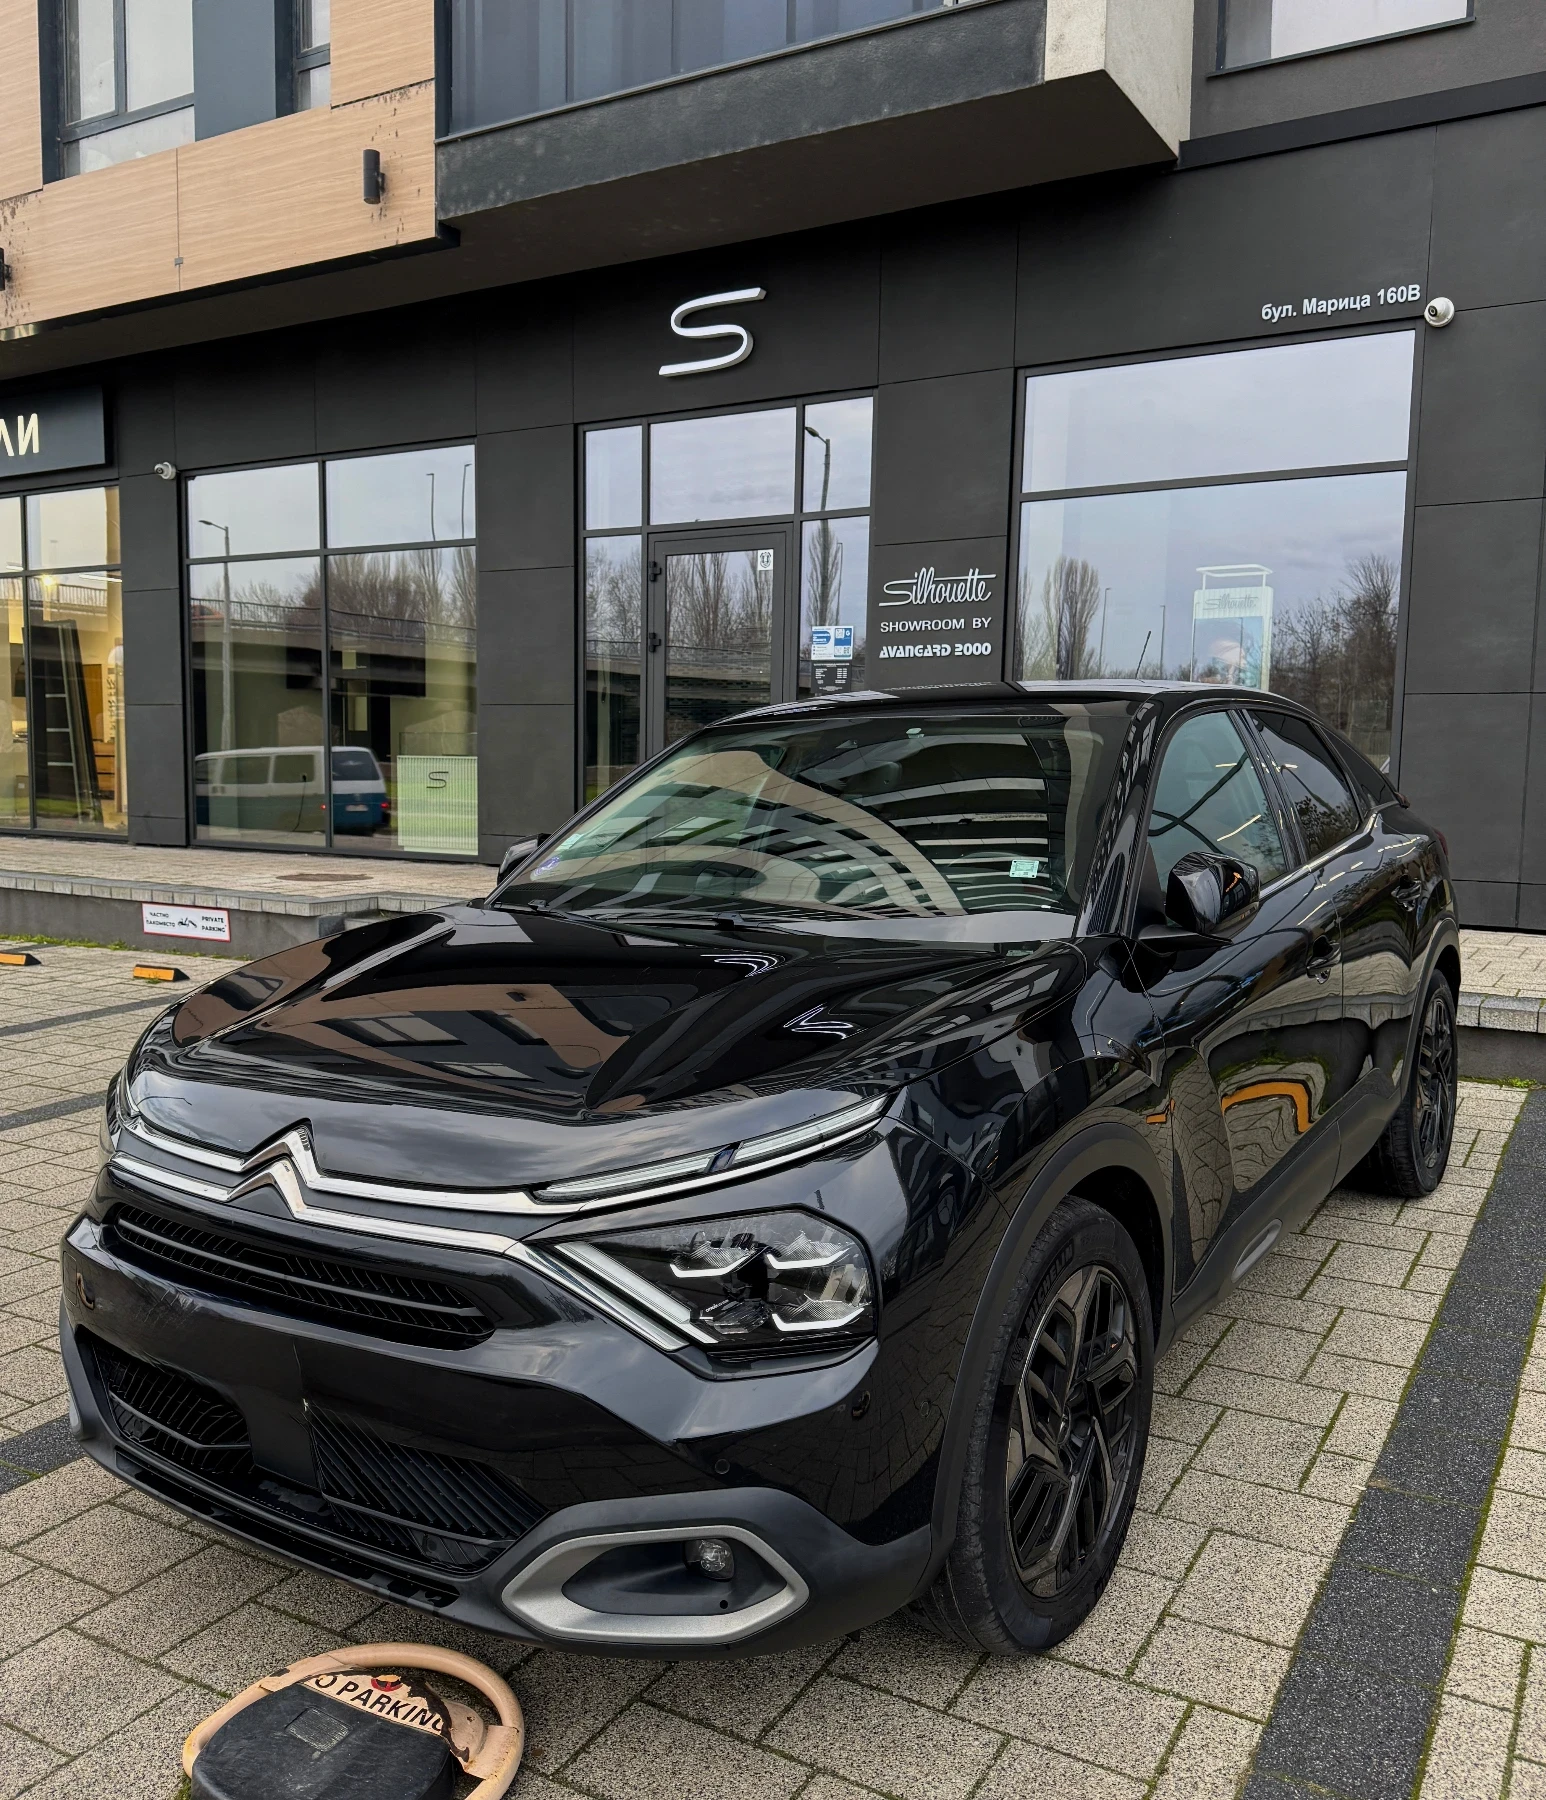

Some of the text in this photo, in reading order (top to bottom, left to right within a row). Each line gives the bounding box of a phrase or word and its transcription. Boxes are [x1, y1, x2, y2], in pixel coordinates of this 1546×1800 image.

[1261, 284, 1421, 323] бул. Марица 160В
[878, 566, 997, 607] Silhouette
[1203, 593, 1259, 611] Silhouette
[880, 617, 992, 633] SHOWROOM BY
[878, 642, 992, 659] AVANGARD 2000
[1023, 1242, 1074, 1335] MICHELIN
